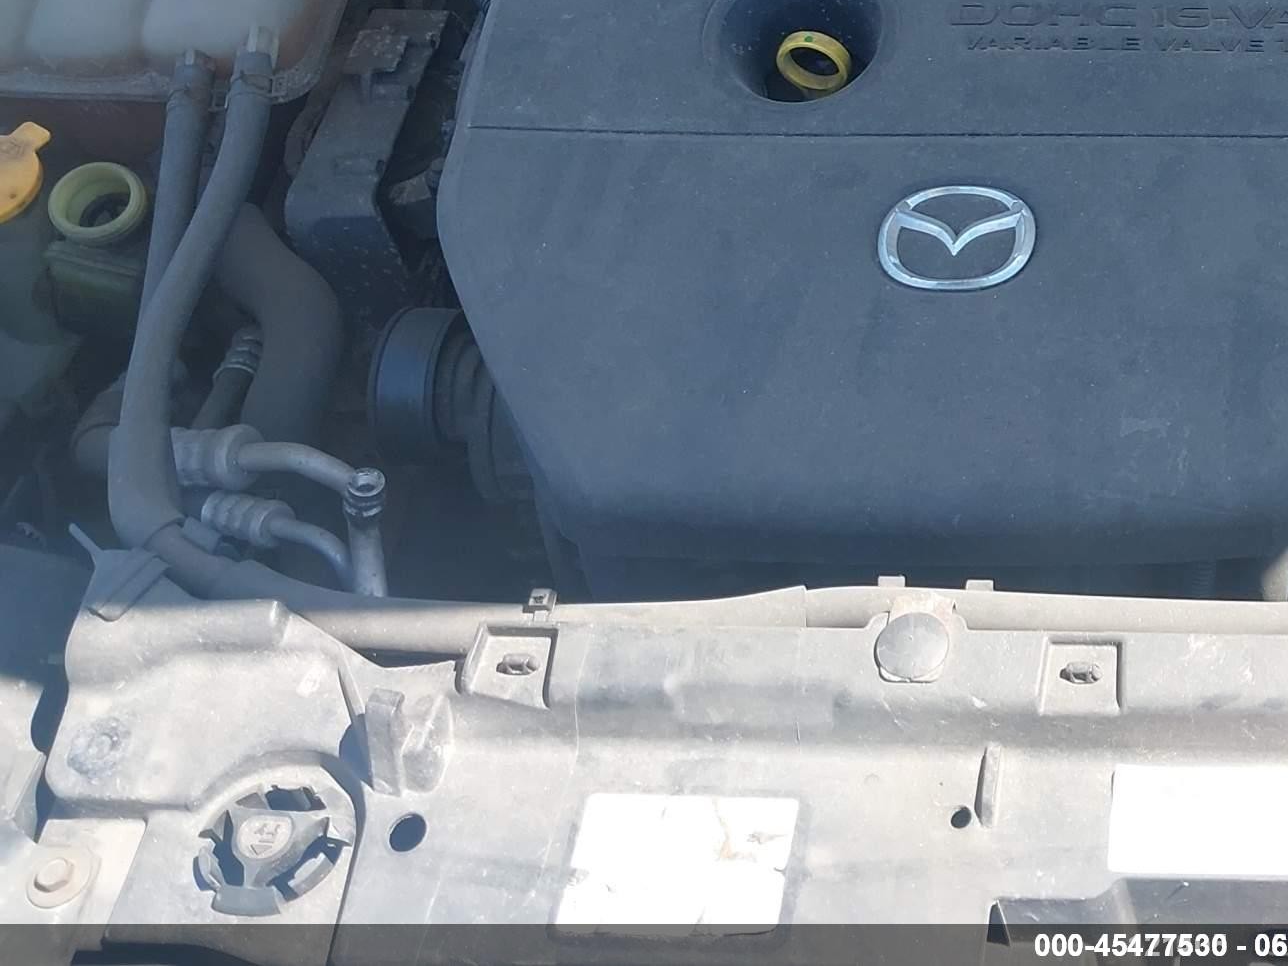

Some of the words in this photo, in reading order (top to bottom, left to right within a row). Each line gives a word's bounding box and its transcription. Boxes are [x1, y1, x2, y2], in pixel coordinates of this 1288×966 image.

[950, 4, 1138, 27] DOHC
[967, 36, 1142, 51] VARIABLE
[1154, 38, 1265, 53] VALVE
